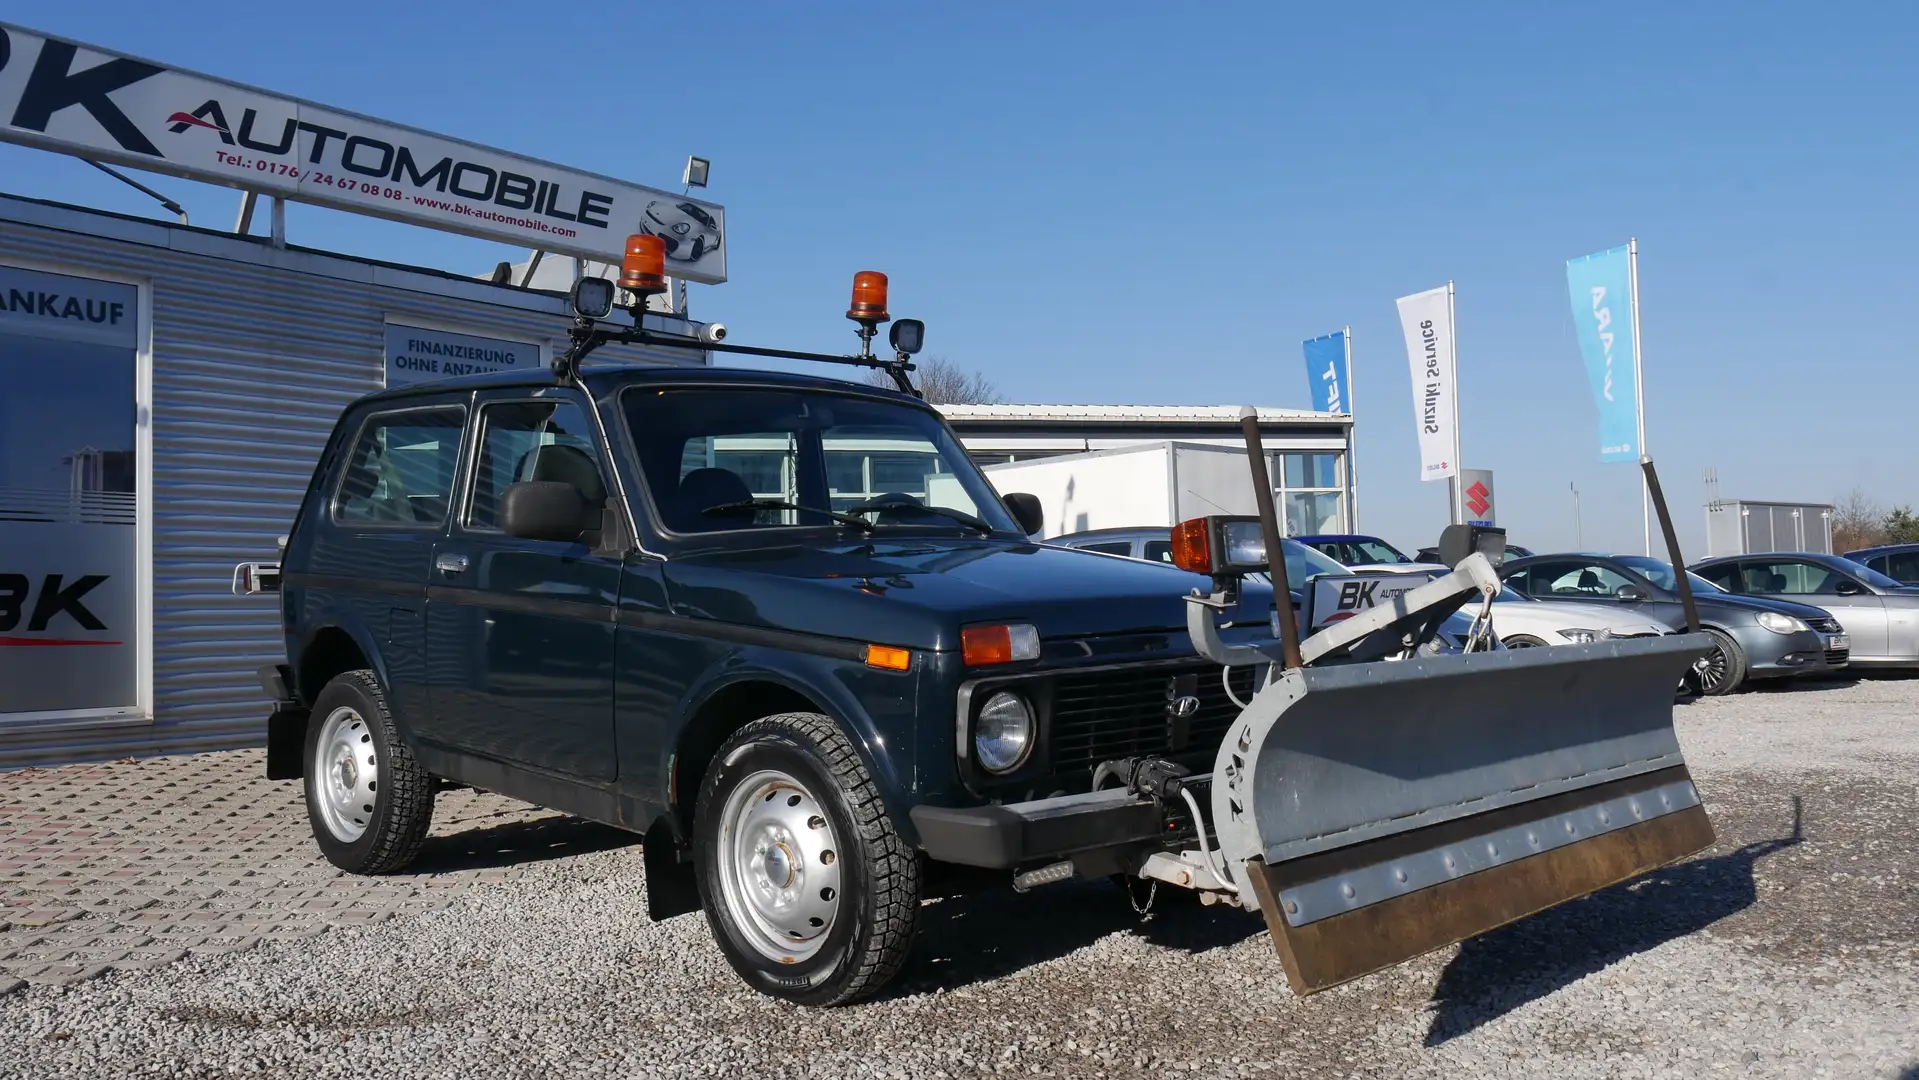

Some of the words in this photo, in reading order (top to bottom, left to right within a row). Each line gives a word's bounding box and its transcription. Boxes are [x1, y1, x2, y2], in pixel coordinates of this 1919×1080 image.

[0, 27, 168, 158] K
[165, 99, 613, 229] AUTOMOBILE
[216, 151, 252, 169] Tel.:
[256, 160, 299, 178] 0176
[313, 172, 333, 186] 24
[338, 178, 357, 190] 67
[361, 183, 379, 195] 08
[383, 188, 402, 200] 08
[413, 195, 577, 238] www.bk-automobile.com
[395, 355, 438, 373] OHNE
[442, 362, 498, 376] ANZA
[408, 339, 516, 364] FINANZIERUNG
[1337, 581, 1380, 610] BK
